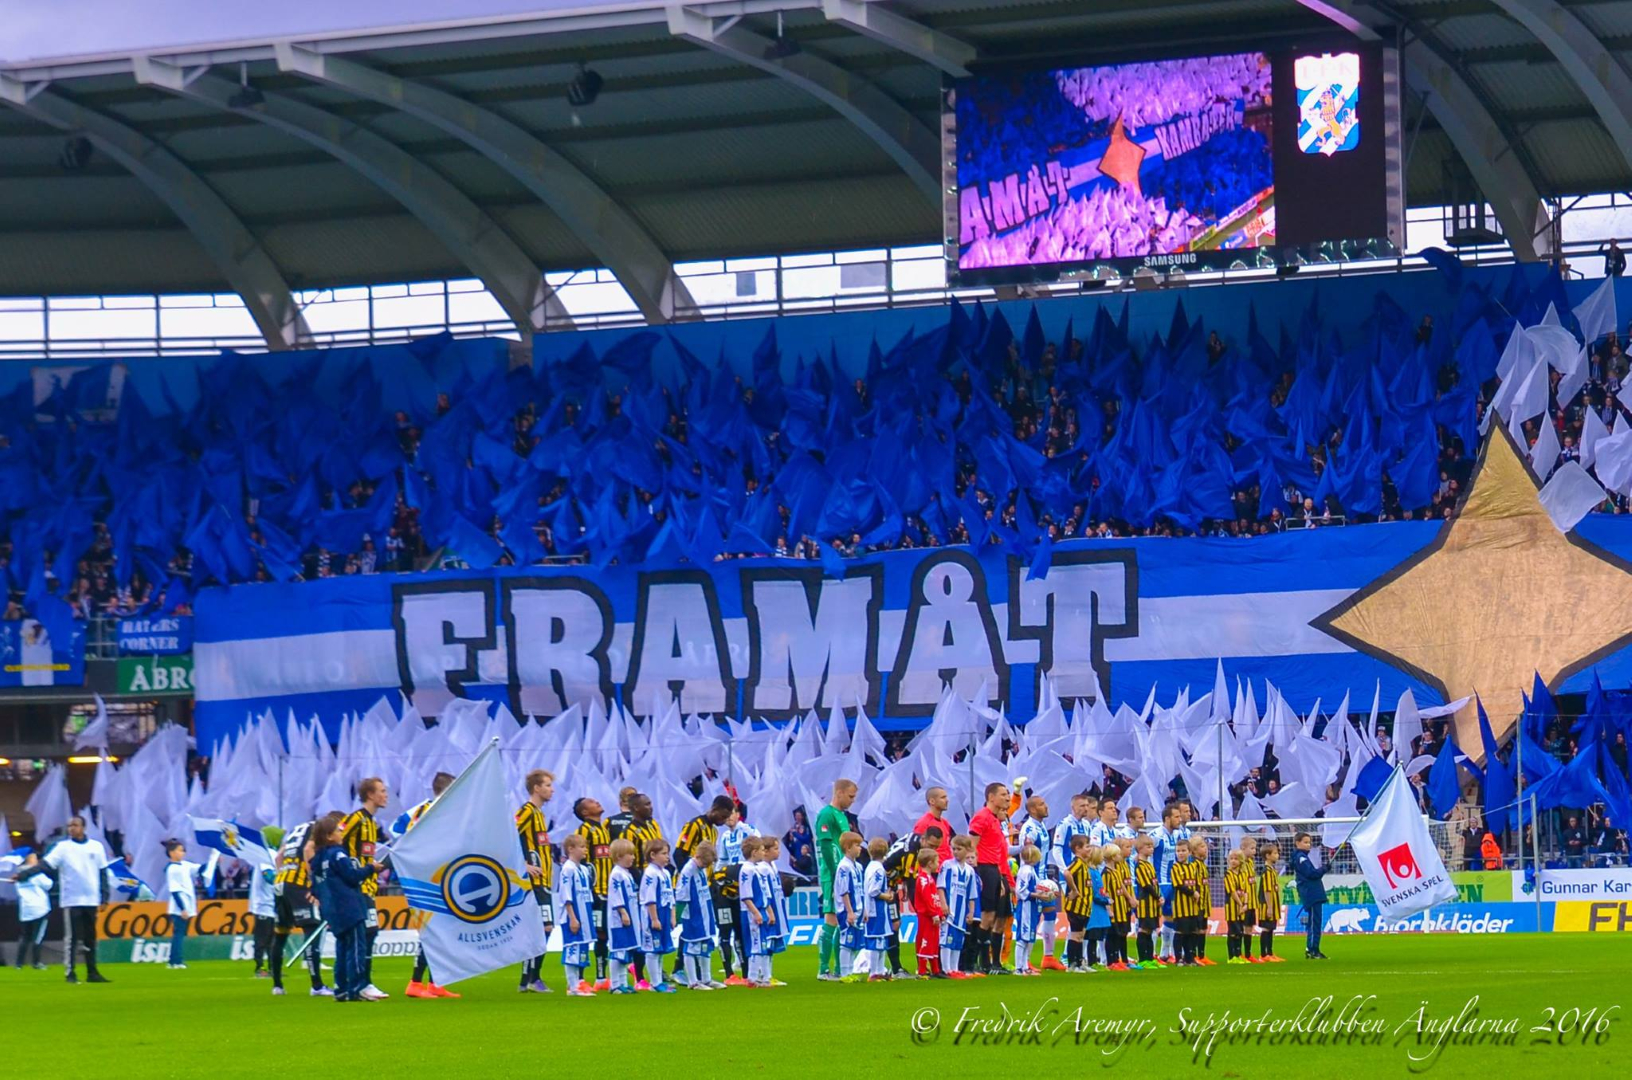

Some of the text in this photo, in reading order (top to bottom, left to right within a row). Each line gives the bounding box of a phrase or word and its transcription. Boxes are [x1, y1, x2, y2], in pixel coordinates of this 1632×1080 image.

[1144, 252, 1197, 267] SAMSUNG
[120, 637, 179, 650] CORNER
[395, 555, 1134, 720] FRAMÅT
[1381, 886, 1421, 907] SVENSKA
[1422, 875, 1444, 890] SPEL
[1542, 879, 1632, 894] Gunnar Kar
[103, 902, 255, 938] Goo Cas
[458, 914, 522, 942] ALLSVENSKAN
